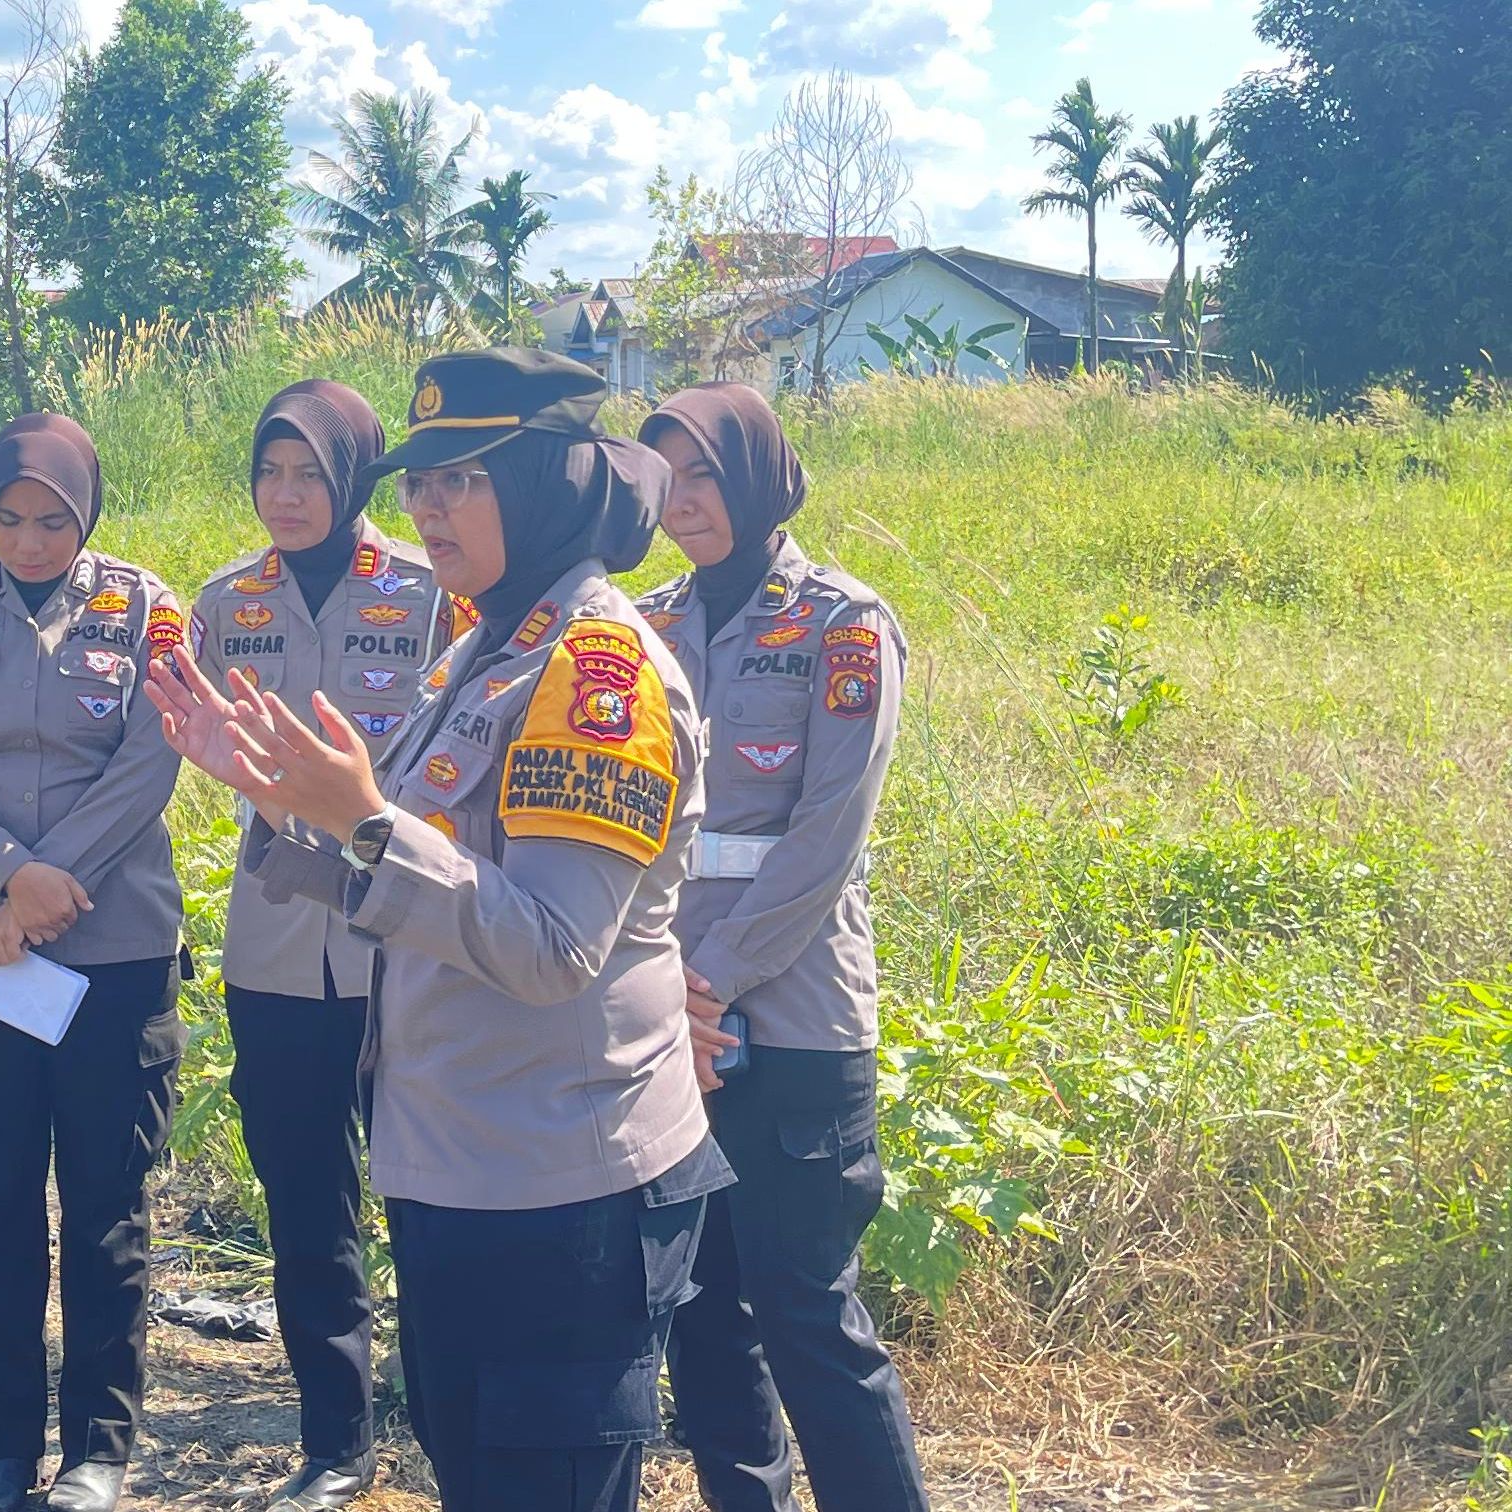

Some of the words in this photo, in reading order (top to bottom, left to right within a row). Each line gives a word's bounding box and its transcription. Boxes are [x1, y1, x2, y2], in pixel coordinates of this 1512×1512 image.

[66, 622, 135, 649] POLRI
[153, 630, 182, 642] RIAU
[224, 635, 285, 657] ENGGAR
[344, 635, 418, 658] POLRI
[738, 653, 813, 677] POLRI
[831, 654, 871, 666] RIAU
[572, 773, 607, 800] PKL
